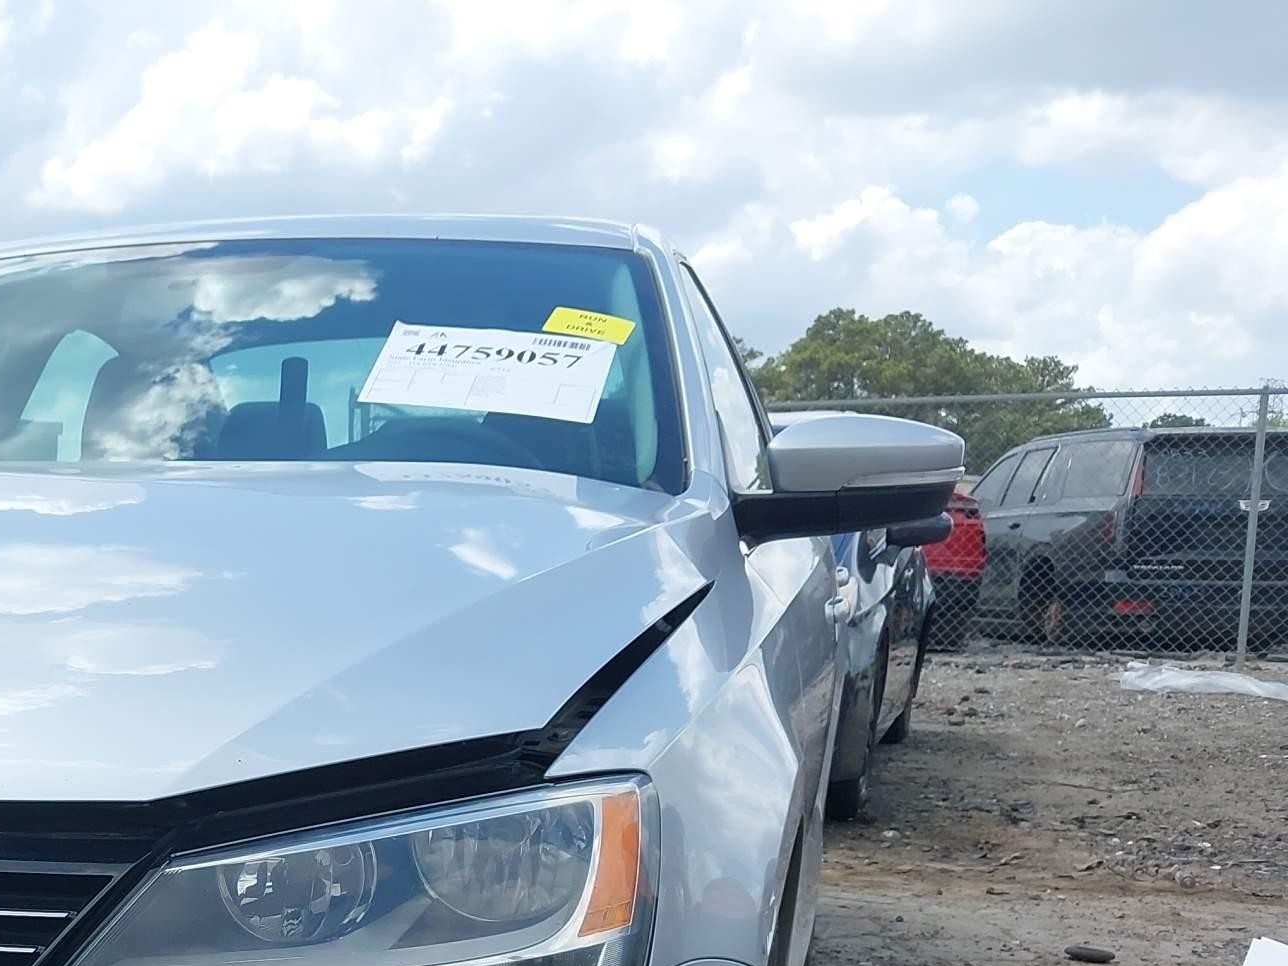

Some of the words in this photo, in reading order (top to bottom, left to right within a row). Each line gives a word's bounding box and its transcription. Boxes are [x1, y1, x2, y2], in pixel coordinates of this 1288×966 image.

[578, 314, 607, 323] RUN
[565, 325, 605, 335] DRIVE
[406, 342, 583, 369] 44759057
